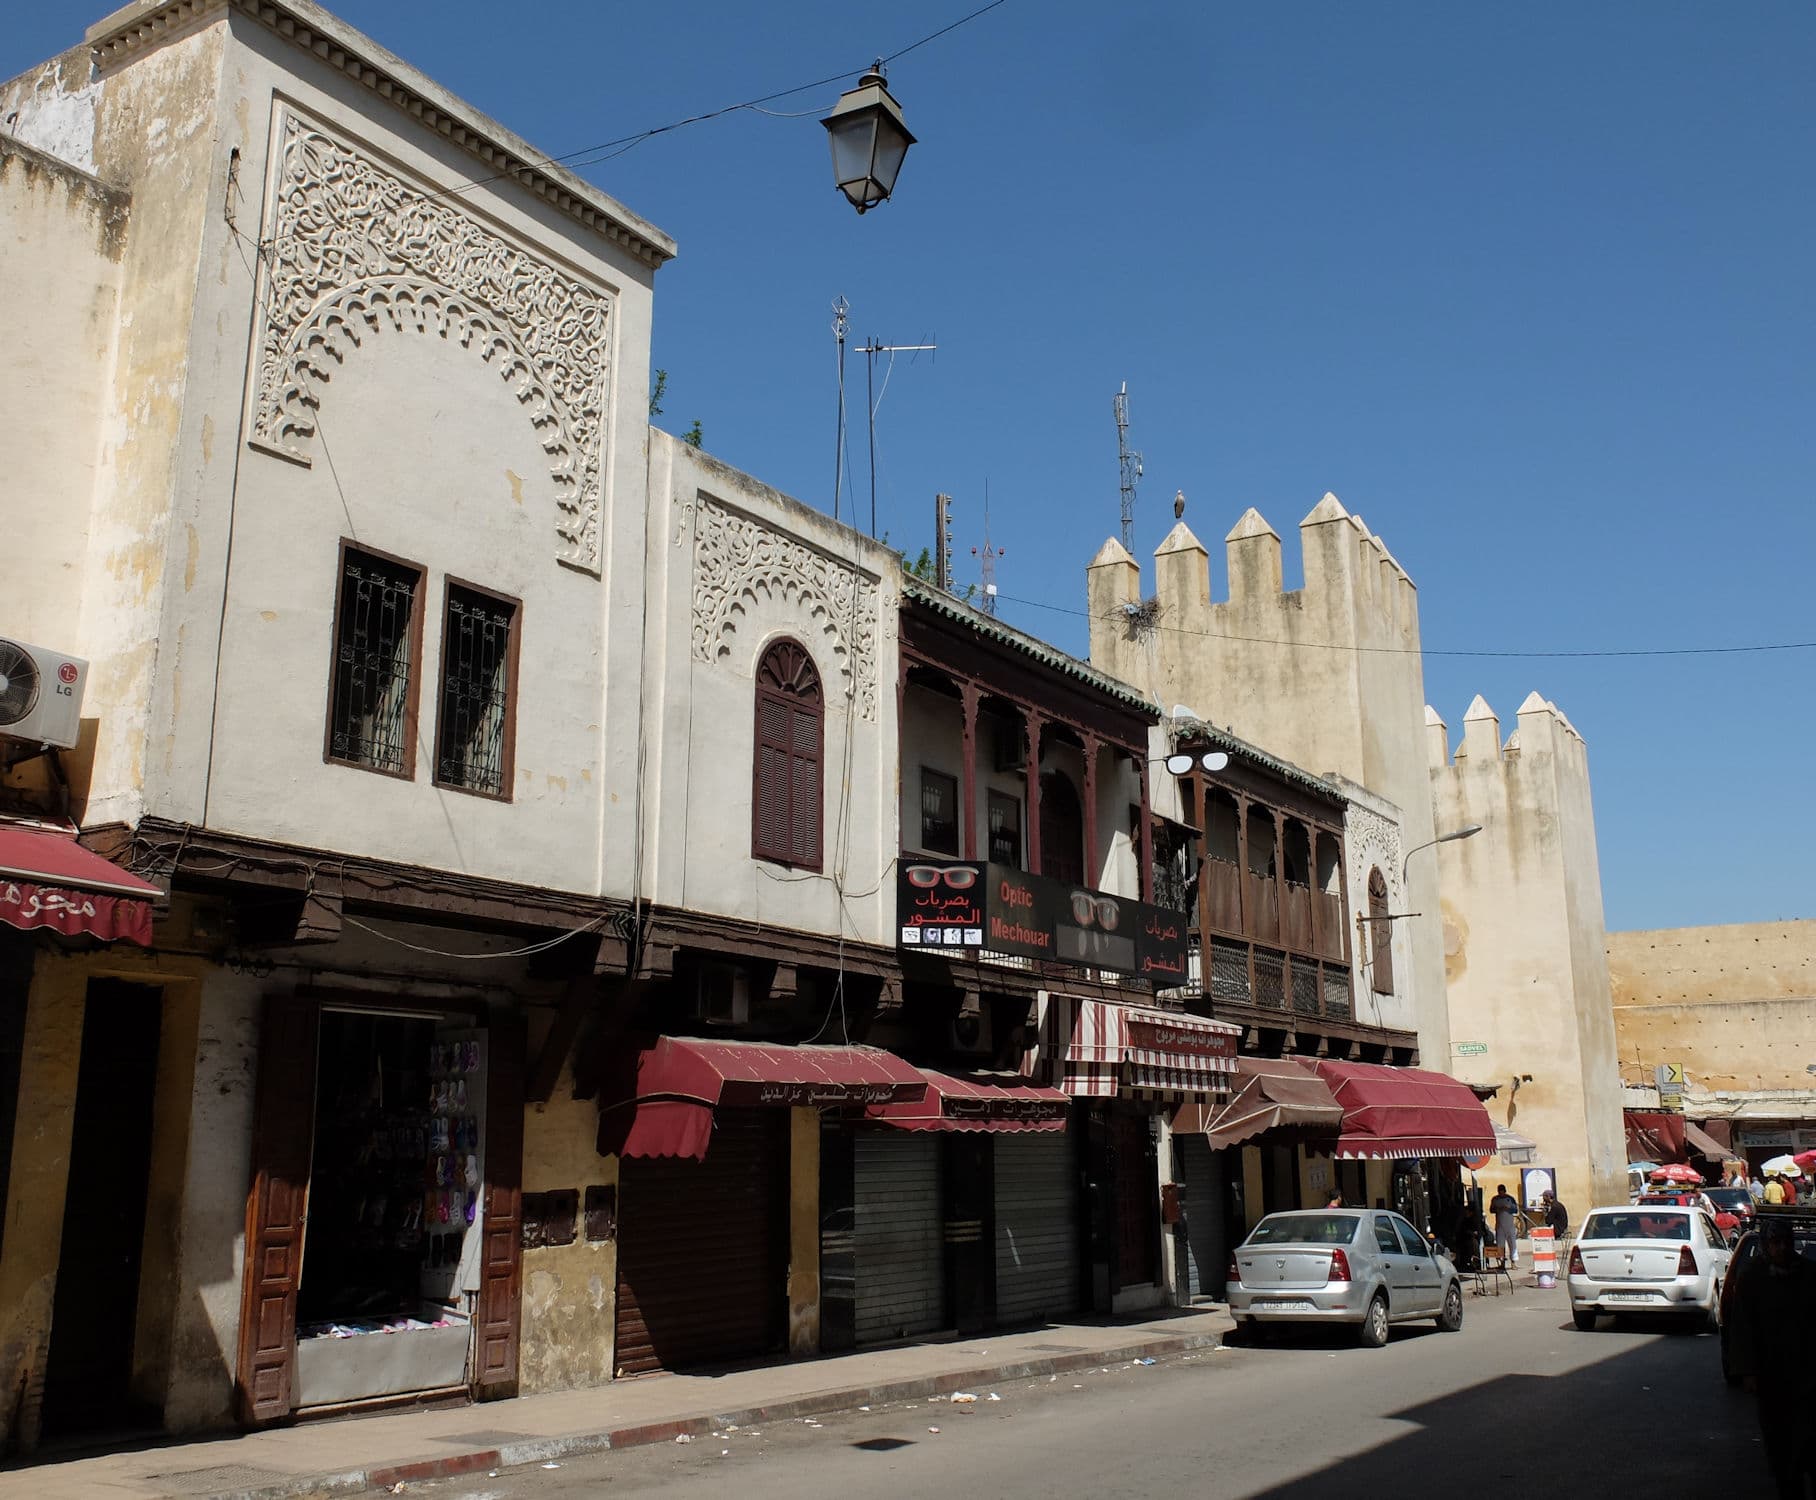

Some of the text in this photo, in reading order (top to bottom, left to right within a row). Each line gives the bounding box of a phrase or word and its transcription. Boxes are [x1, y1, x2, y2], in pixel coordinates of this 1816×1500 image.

[56, 684, 73, 697] LG
[915, 890, 969, 908] بصريات
[1001, 881, 1033, 908] Optic
[904, 909, 980, 926] المشور
[1145, 913, 1178, 941] بصريات
[991, 916, 1049, 947] Mechouar
[1141, 952, 1185, 974] المشور
[1002, 1102, 1056, 1117] مجوهرات
